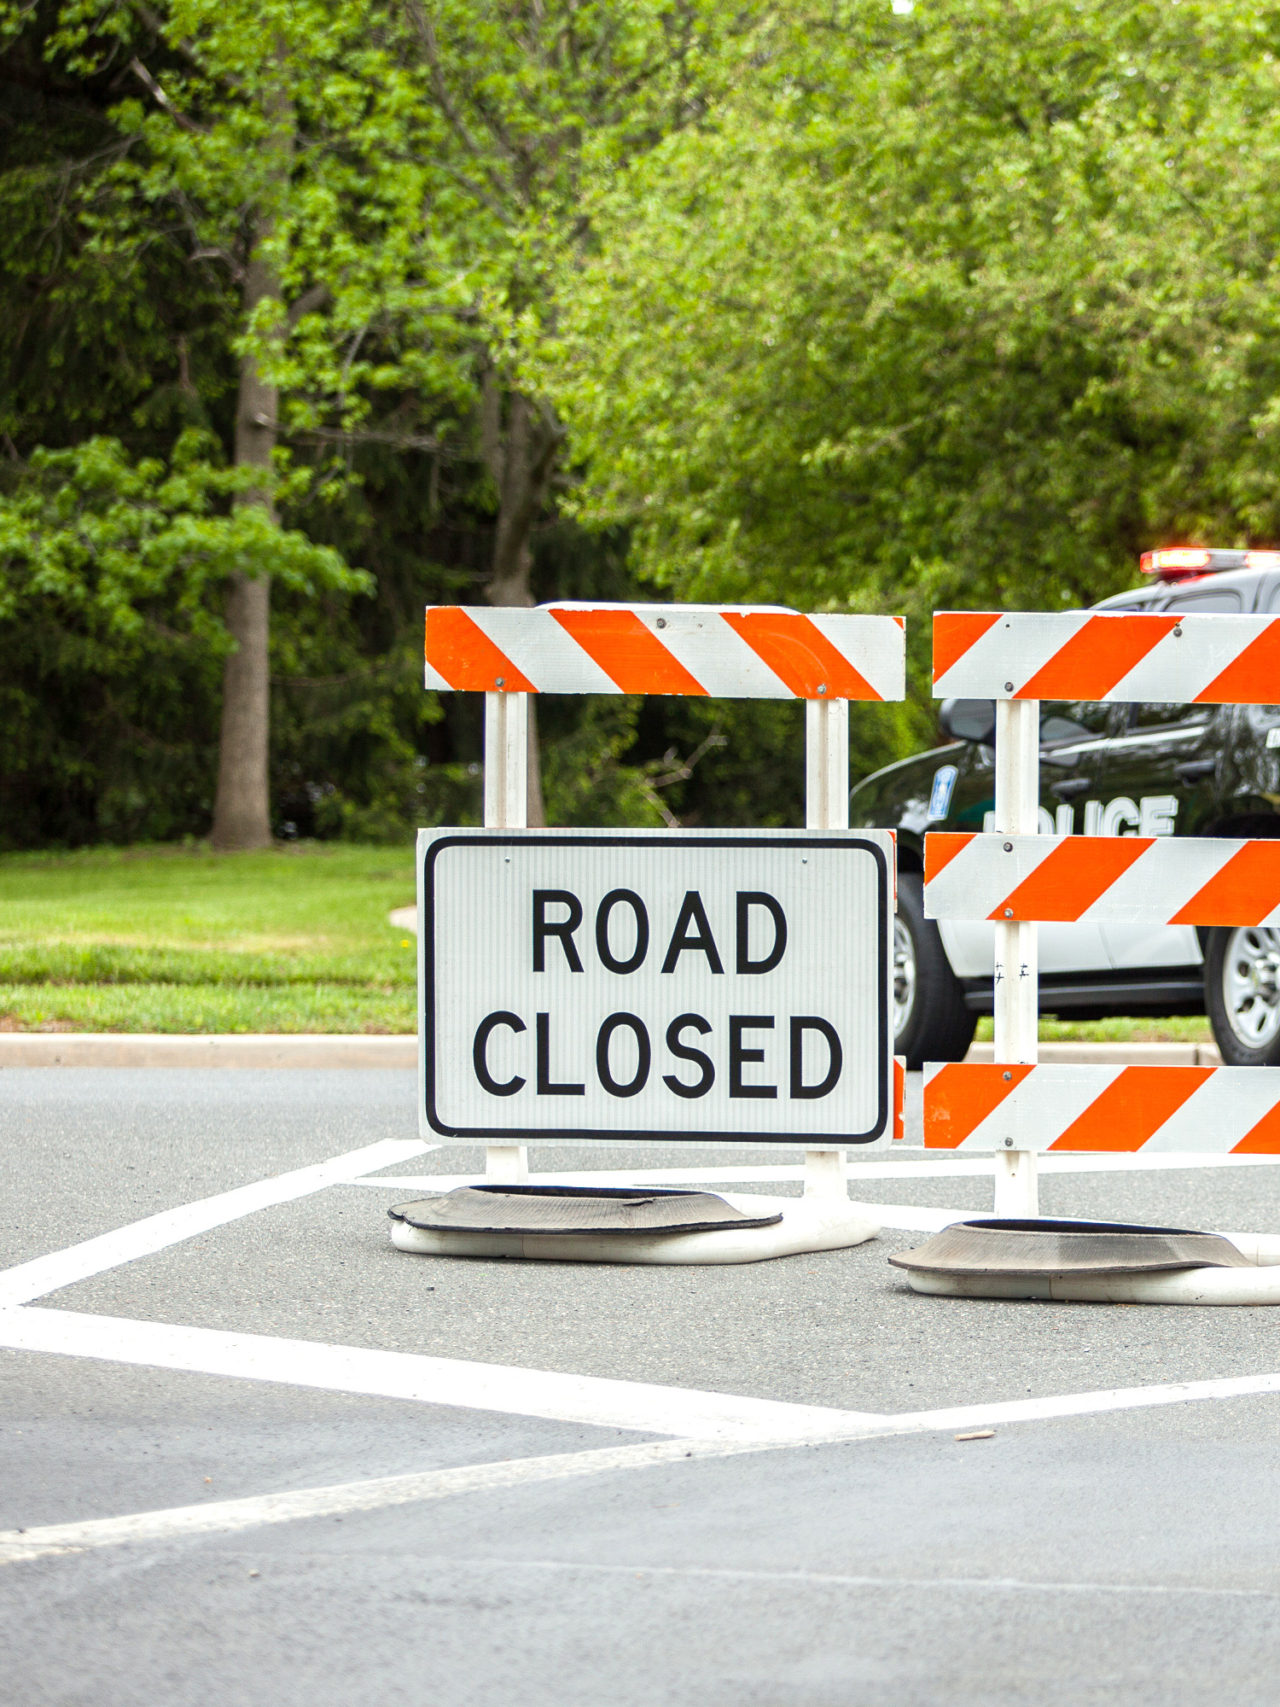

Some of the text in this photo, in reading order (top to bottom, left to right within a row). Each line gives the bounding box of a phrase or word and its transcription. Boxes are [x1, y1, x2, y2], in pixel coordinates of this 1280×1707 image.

[983, 795, 1179, 836] ICE
[533, 888, 788, 975] ROAD
[473, 1010, 843, 1100] CLOSED
